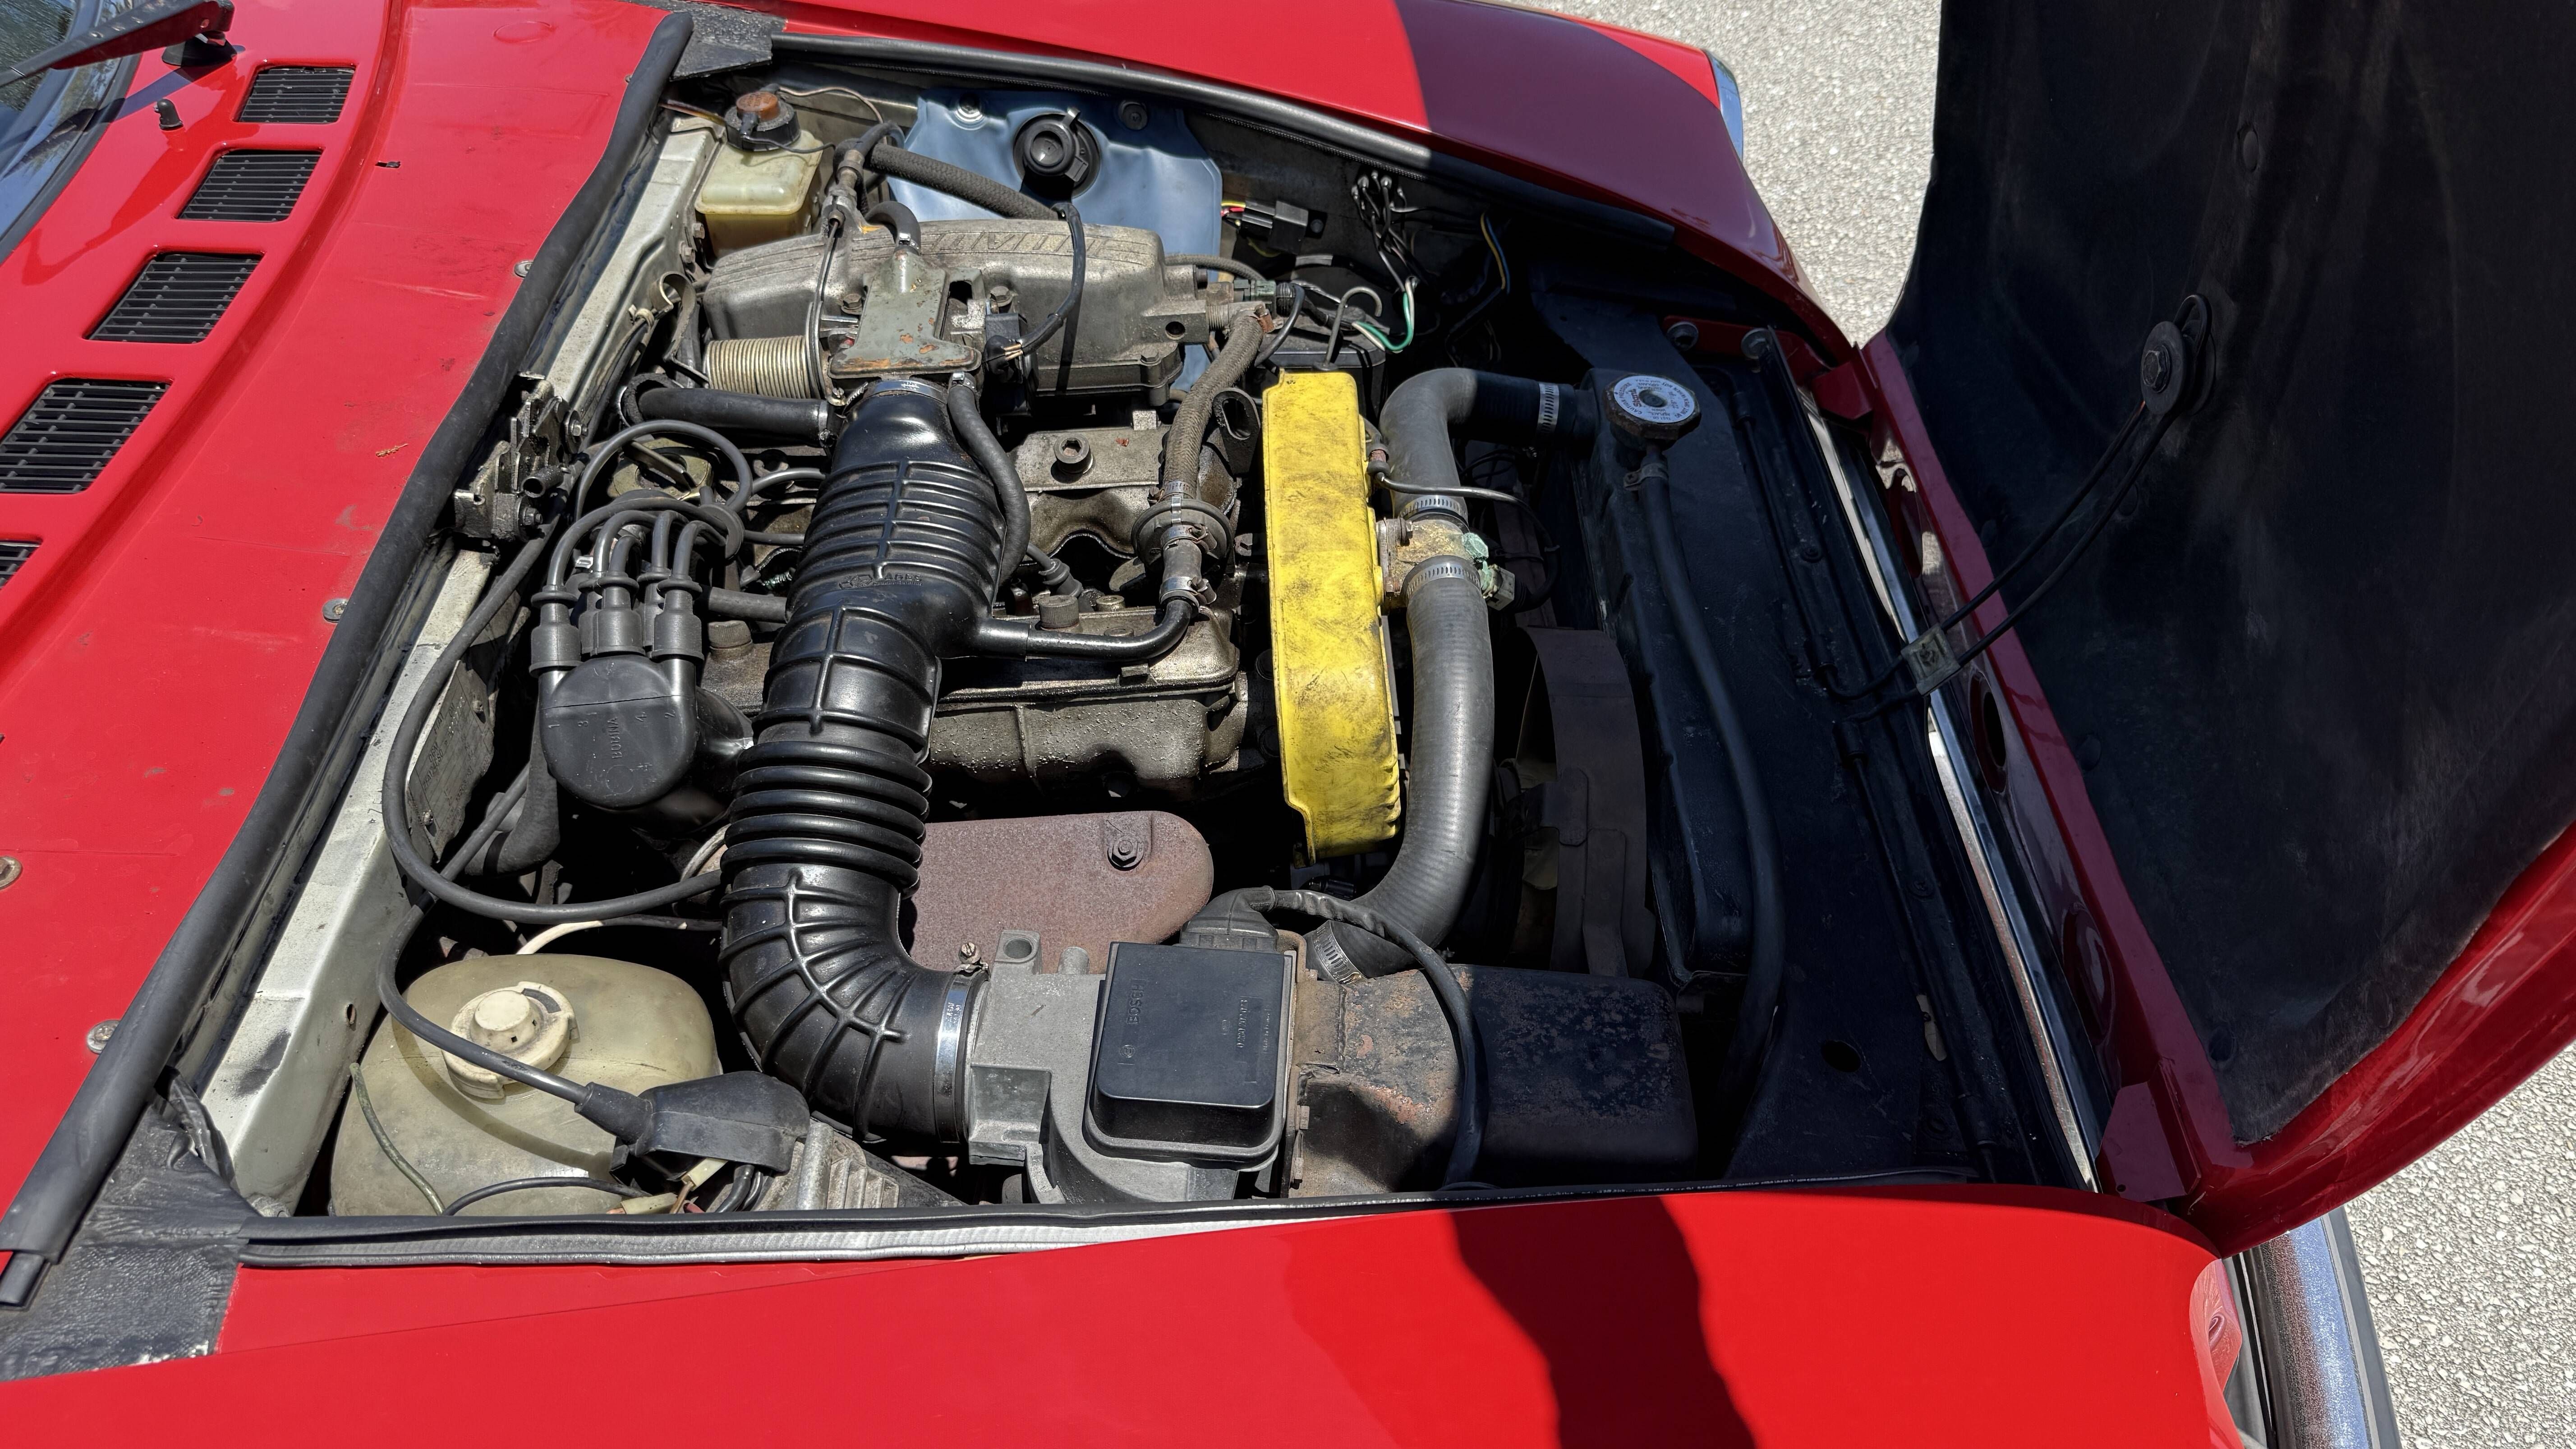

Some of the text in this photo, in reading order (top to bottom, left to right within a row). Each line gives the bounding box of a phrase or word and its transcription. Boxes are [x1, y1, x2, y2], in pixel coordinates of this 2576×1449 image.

[1621, 400, 1642, 414] CAUTION
[607, 717, 622, 759] BOBINA
[1127, 984, 1144, 1025] BOSCH
